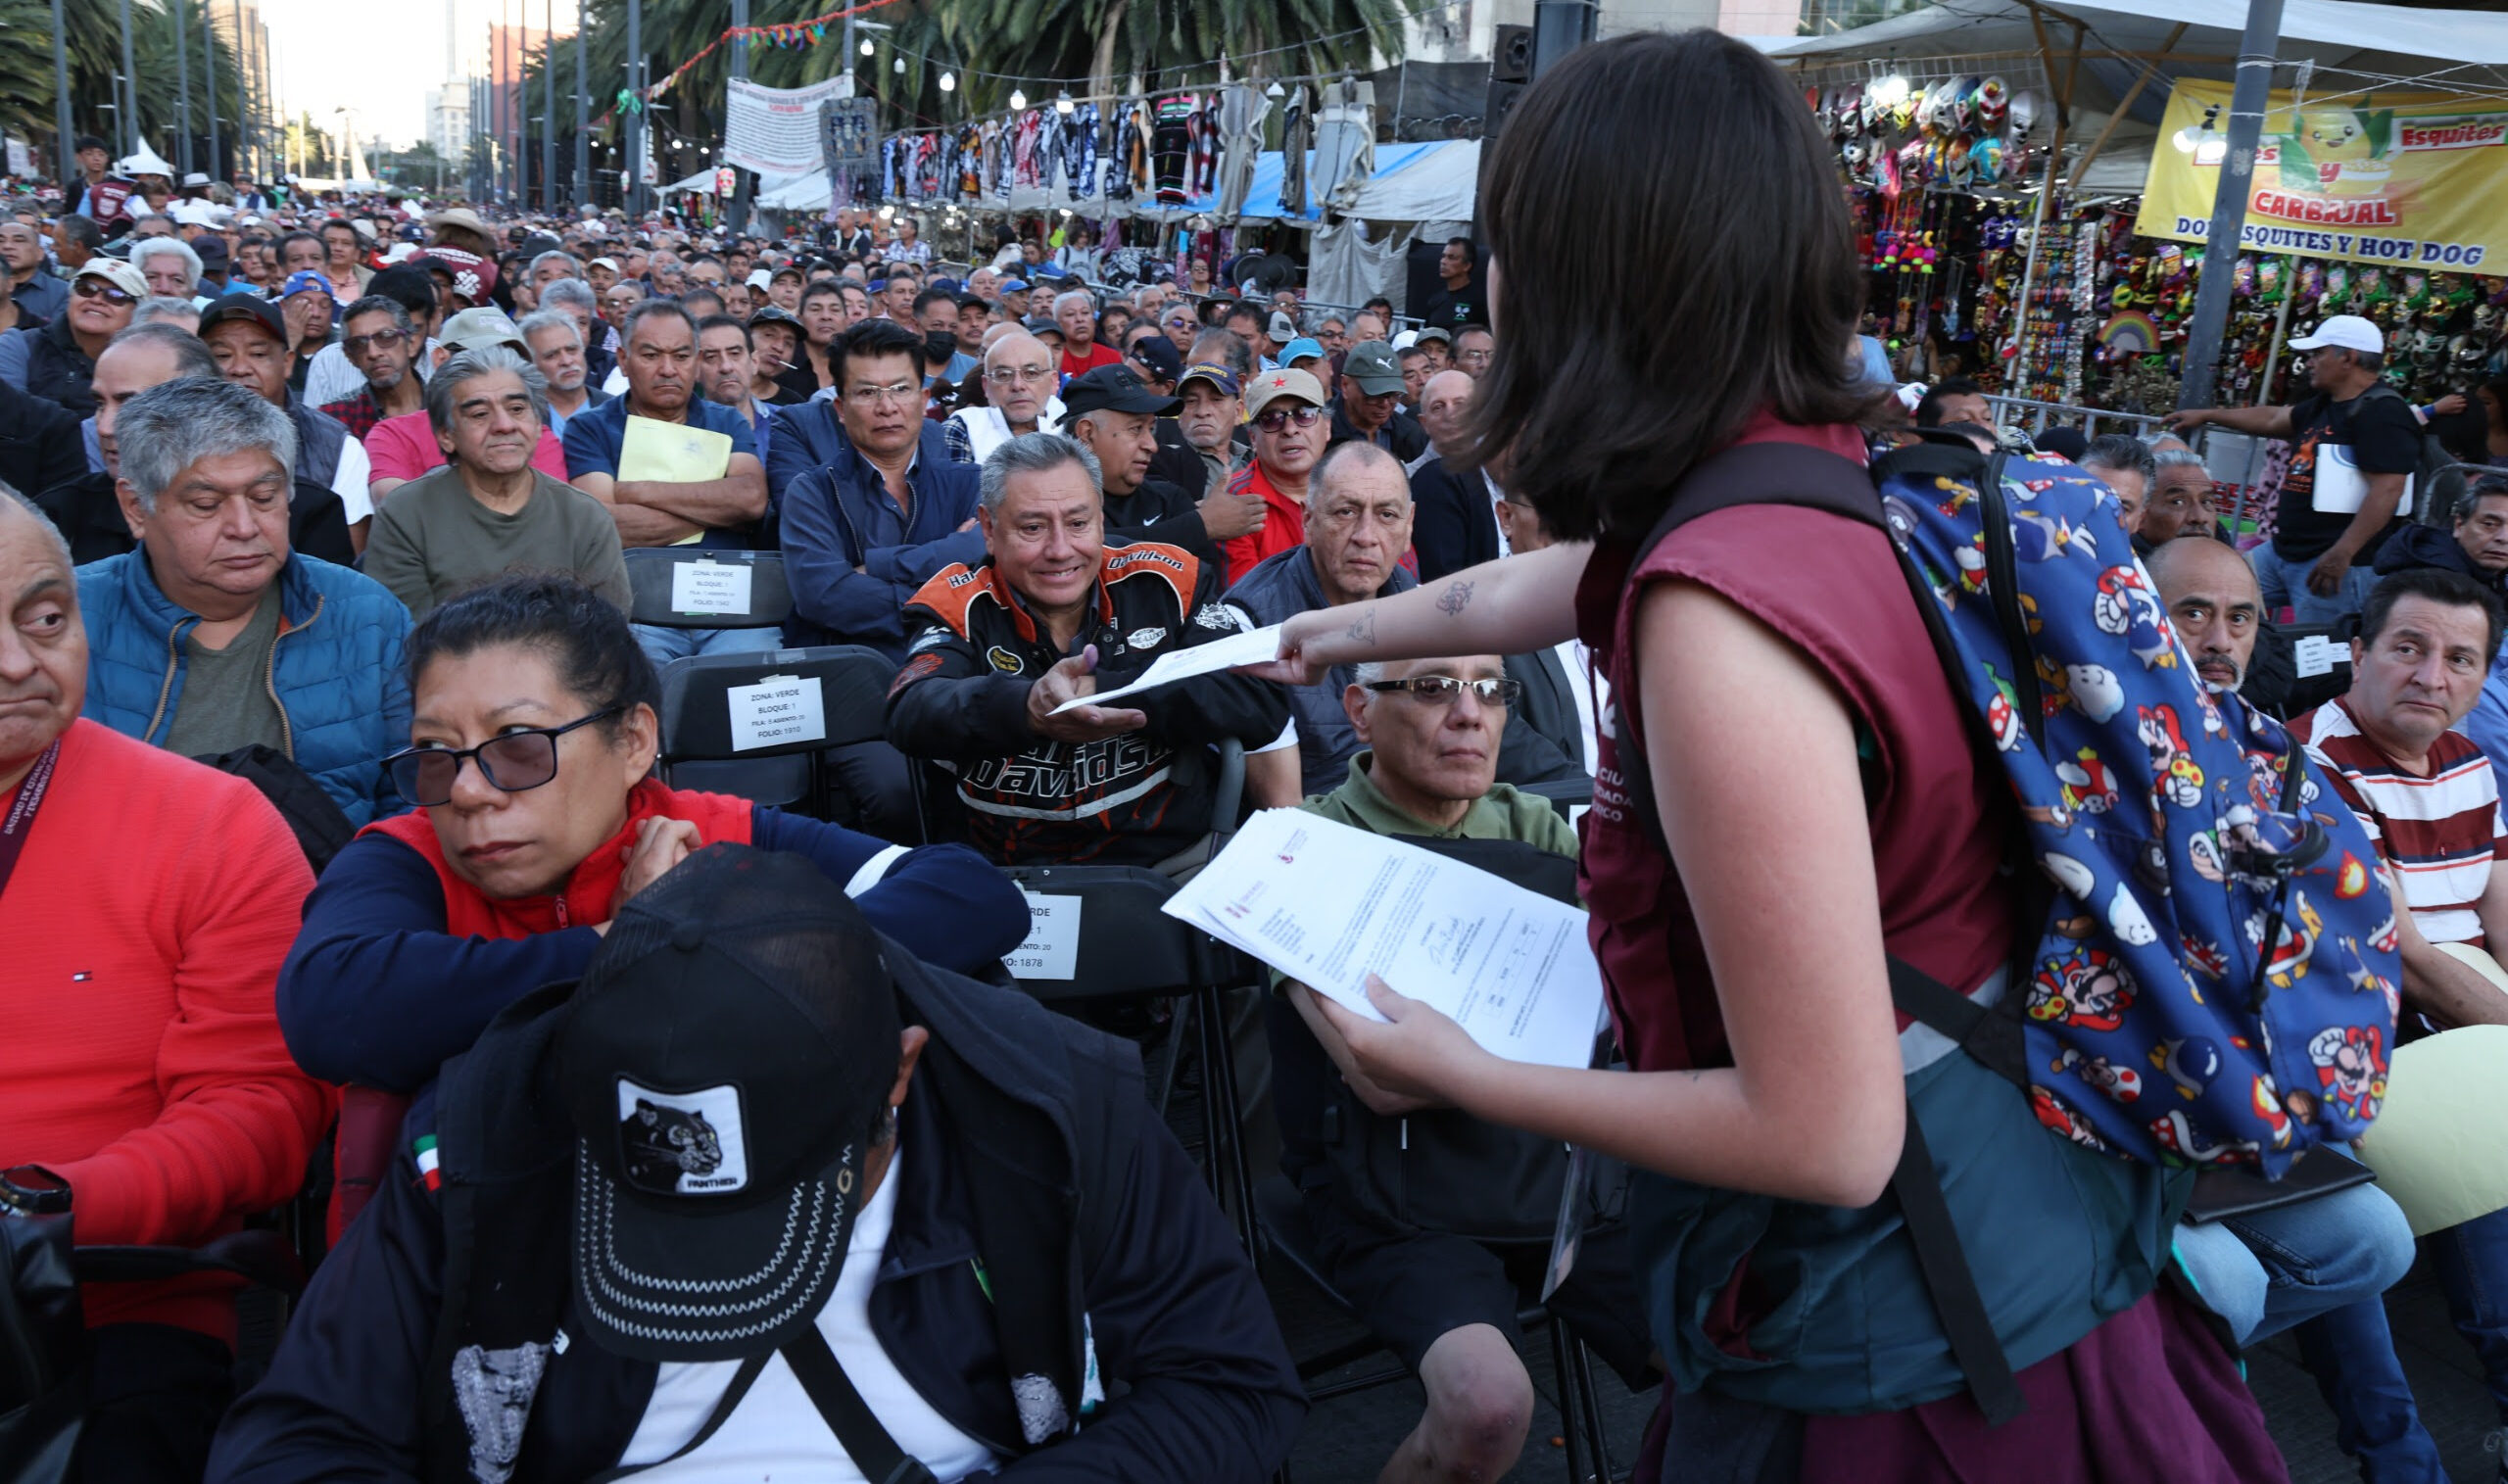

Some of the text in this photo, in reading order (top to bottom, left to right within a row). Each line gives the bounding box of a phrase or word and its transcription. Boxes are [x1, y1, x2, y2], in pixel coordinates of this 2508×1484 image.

[2401, 124, 2506, 146] Esquites
[2254, 192, 2394, 224] CARBAJAL
[2338, 235, 2353, 254] Y
[2358, 237, 2415, 260] HOT
[2421, 243, 2484, 265] DOG
[1107, 550, 1183, 572] Davidson
[750, 689, 800, 701] ZONA: VERDE
[757, 703, 790, 714] BLOQUE:
[757, 729, 784, 739] FOLIO:
[964, 735, 1174, 798] Davids
[1030, 907, 1051, 917] RDE
[1020, 958, 1043, 968] 1878
[687, 1176, 738, 1188] PANTHER
